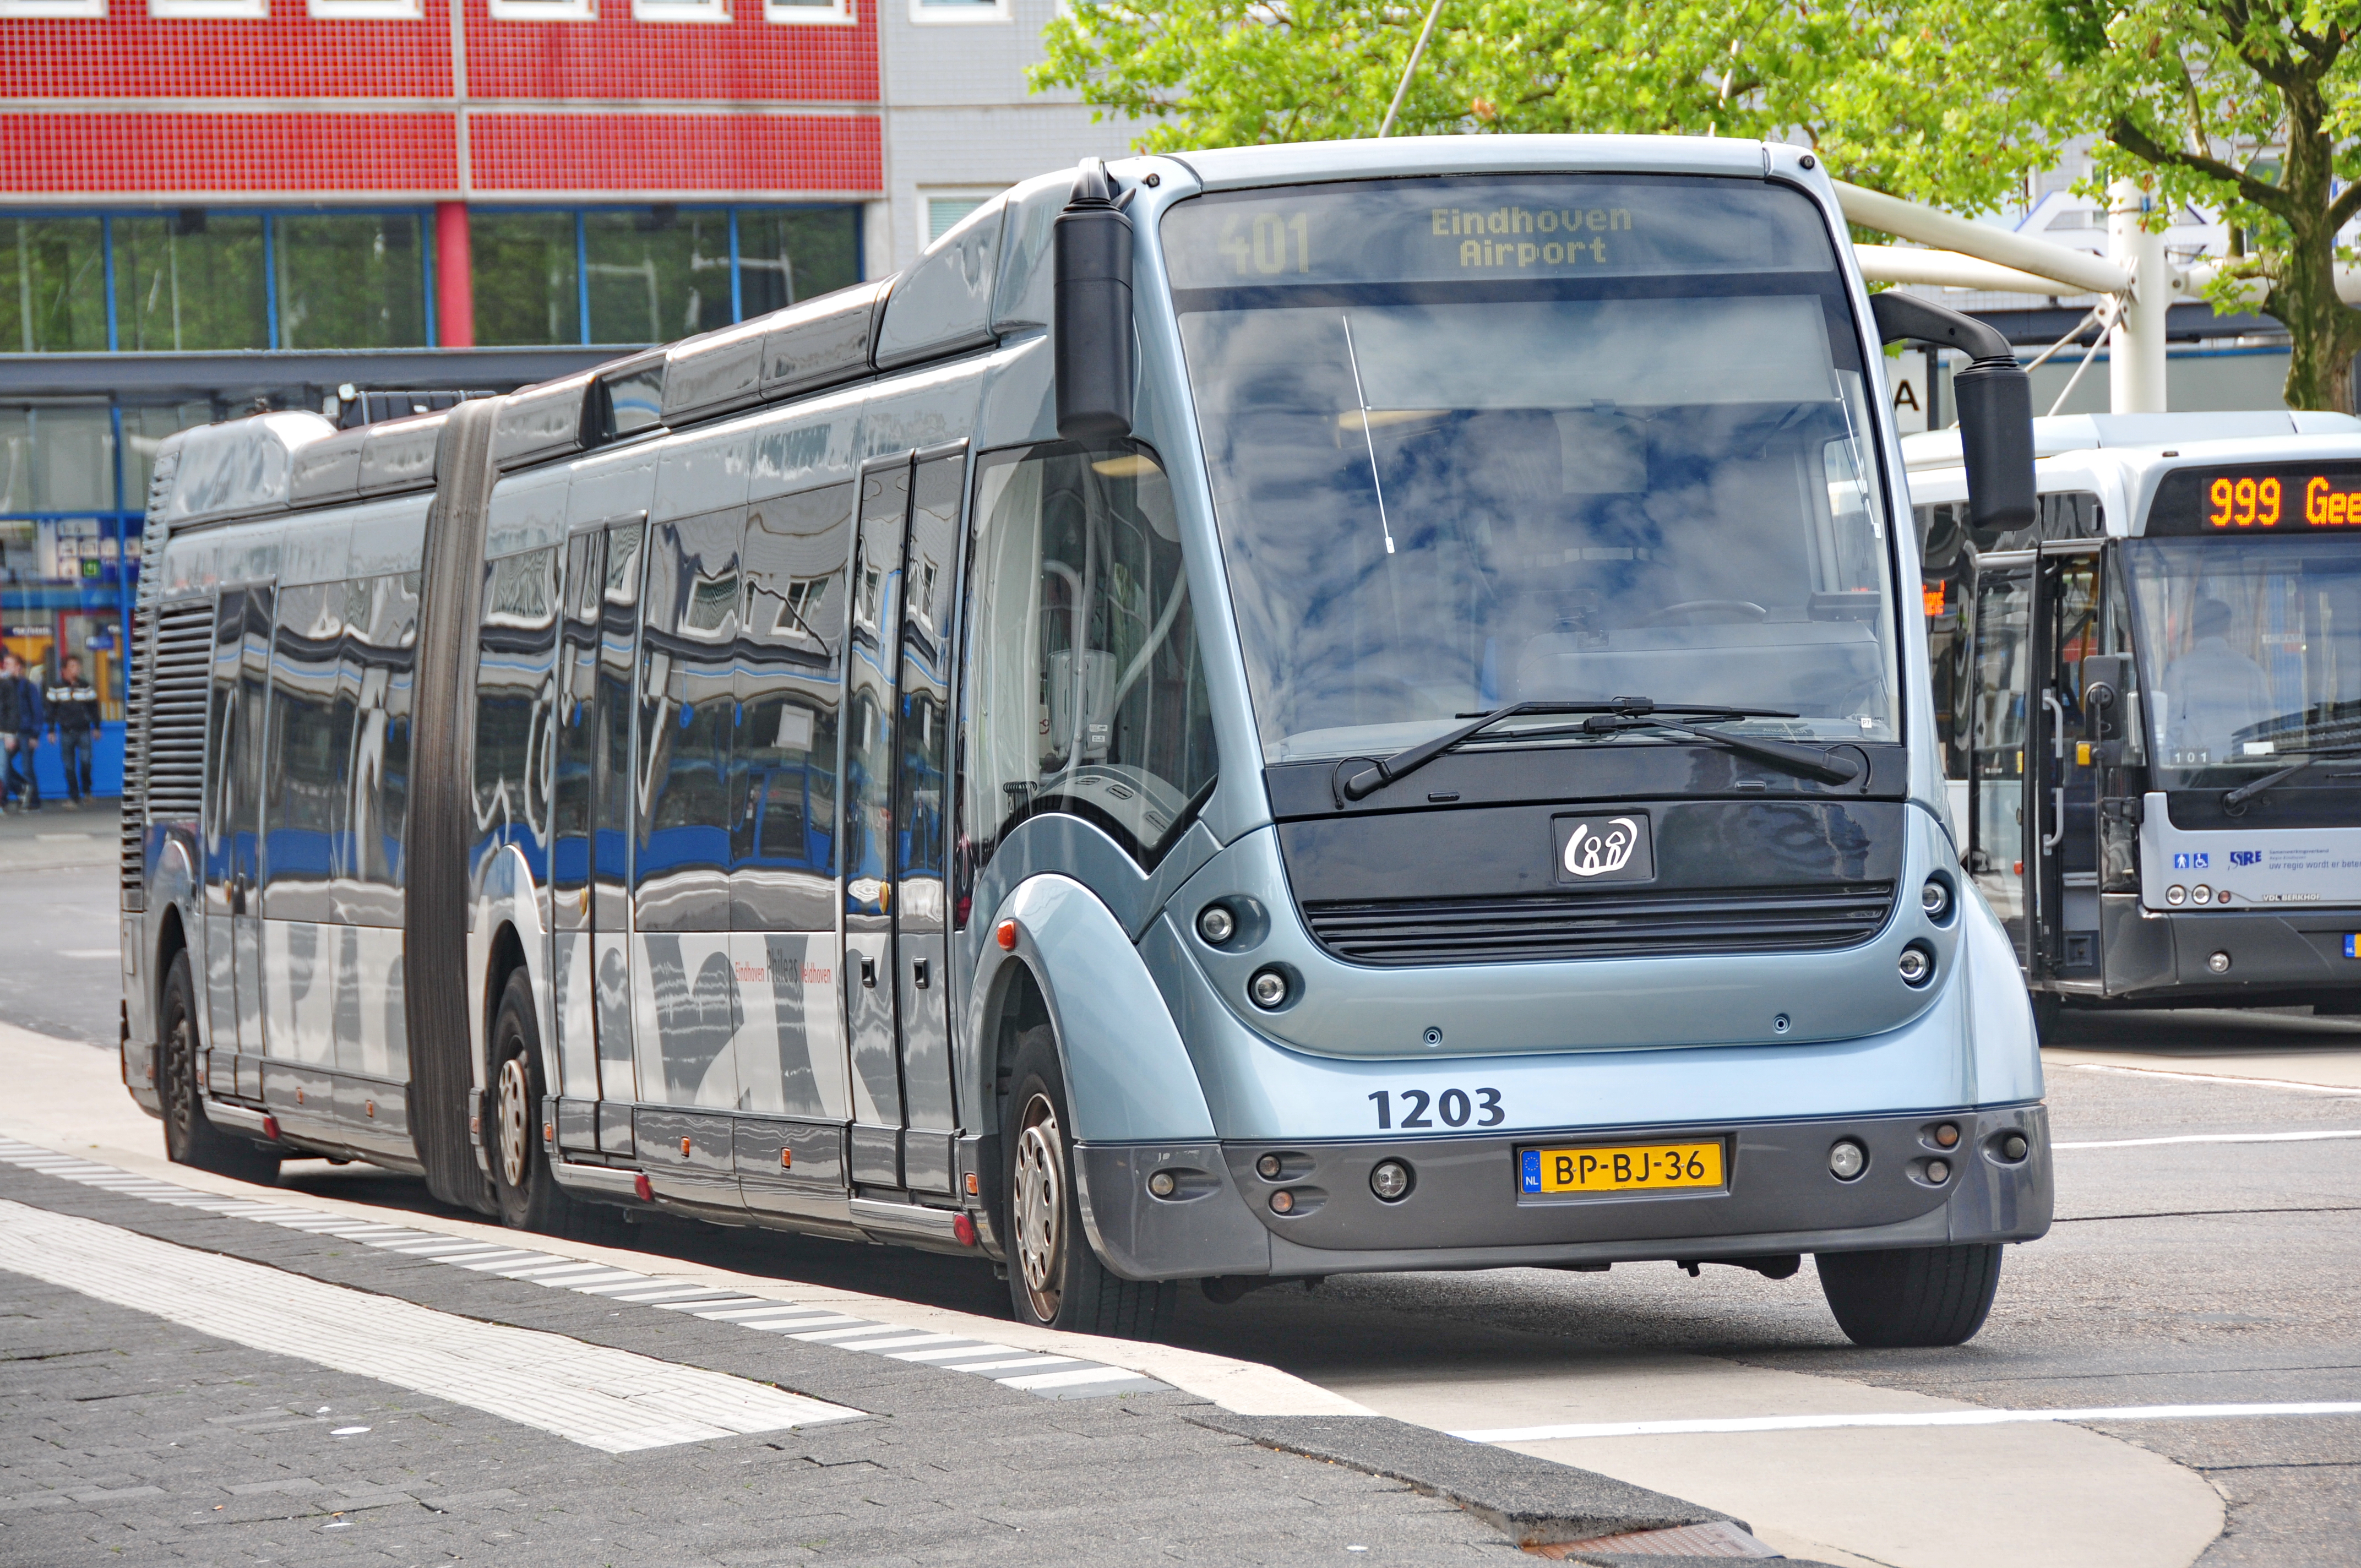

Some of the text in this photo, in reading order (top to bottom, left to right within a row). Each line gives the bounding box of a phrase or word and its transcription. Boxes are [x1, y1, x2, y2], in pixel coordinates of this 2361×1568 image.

[1218, 207, 1631, 274] 401 Eindhoven
[1460, 236, 1606, 267] Airport
[1895, 379, 1920, 411] A
[2210, 476, 2361, 526] 999 Gee
[2230, 851, 2262, 869] SRE
[2284, 862, 2304, 870] regio
[2306, 860, 2329, 868] wordt
[735, 948, 831, 983] Eindhoven Phileas Veldhoven
[1368, 1087, 1505, 1129] 1203
[1526, 1150, 1705, 1185] NL BP-BJ-36
